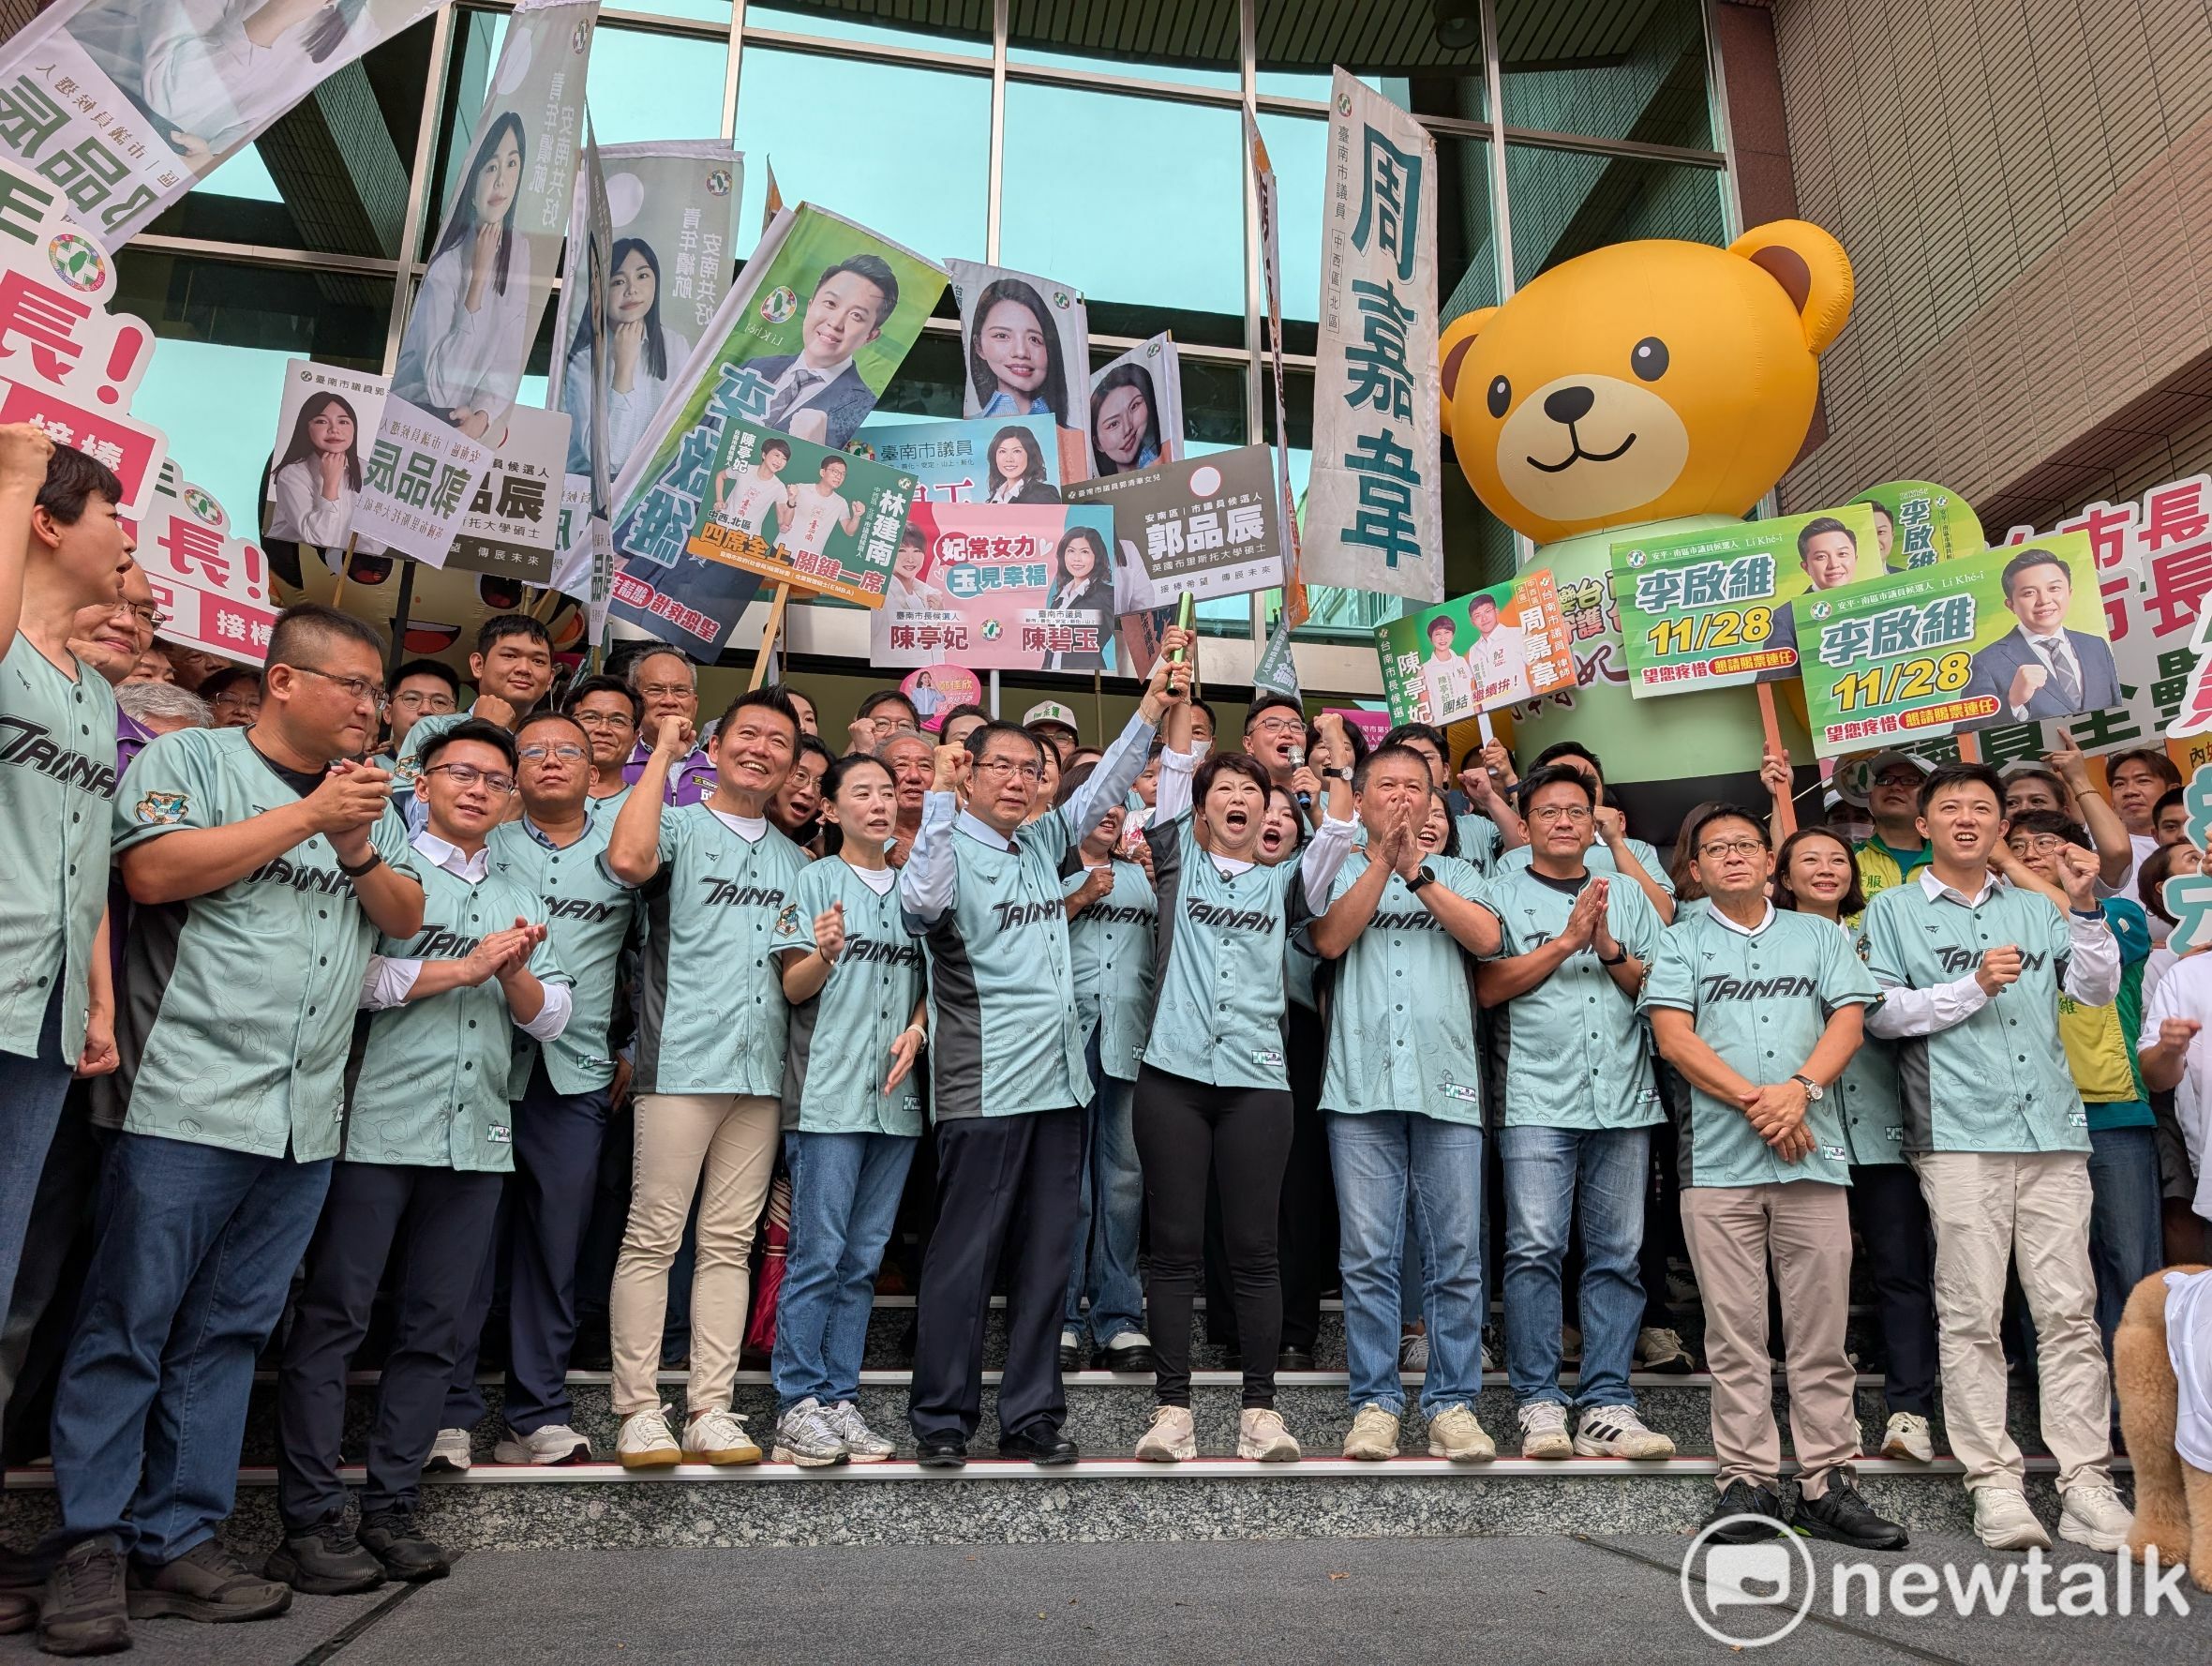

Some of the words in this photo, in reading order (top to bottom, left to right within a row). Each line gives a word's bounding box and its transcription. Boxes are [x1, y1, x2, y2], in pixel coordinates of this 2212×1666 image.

[1335, 126, 1349, 219] 臺南市議員
[1331, 235, 1342, 286] 中西區
[1328, 295, 1339, 329] 北區
[1341, 121, 1423, 569] 周嘉韋
[315, 373, 391, 398] 臺南市議員郭
[733, 432, 756, 473] 陳亭妃
[881, 440, 974, 461] 臺南市議員
[1078, 473, 1161, 498] 臺南市議員郭清華女兒
[864, 489, 906, 567] 林建南
[1146, 504, 1265, 561] 郭品辰
[478, 546, 540, 566] 傳辰未來
[699, 522, 791, 565] 四席全上
[793, 549, 886, 593] 關鍵一席
[940, 535, 1035, 563] 妃常女力
[1152, 544, 1265, 573] 英國布里斯托大學碩士
[952, 563, 1048, 593] 玉見幸福
[1160, 578, 1208, 594] 接棒希望
[1221, 566, 1270, 582] 傳辰未來
[1637, 555, 1773, 612] 李啟維
[896, 610, 960, 622] 臺南市長候選人
[1039, 610, 1082, 619] 臺南市議員
[1542, 591, 1565, 652] 台南市議員
[1649, 607, 1771, 655] 11/28
[1820, 594, 1976, 667] 李啟維
[890, 625, 969, 651] 陳亭妃
[1022, 626, 1099, 653] 陳碧玉
[1519, 606, 1559, 687] 周嘉韋
[1380, 640, 1405, 728] 台南市長候選
[1557, 658, 1571, 679] 律師
[1643, 662, 1708, 684] 望您疼惜
[1714, 652, 1794, 674] 懇請賜票連任
[1832, 653, 1971, 713] 11/28
[1397, 652, 1433, 724] 陳亭妃
[1442, 695, 1468, 716] 團結
[1827, 715, 1899, 743] 望您疼惜
[1906, 700, 1995, 728] 懇請賜票連任
[1185, 897, 1280, 935] TAINAN
[1699, 972, 1817, 1005] TAINAN
